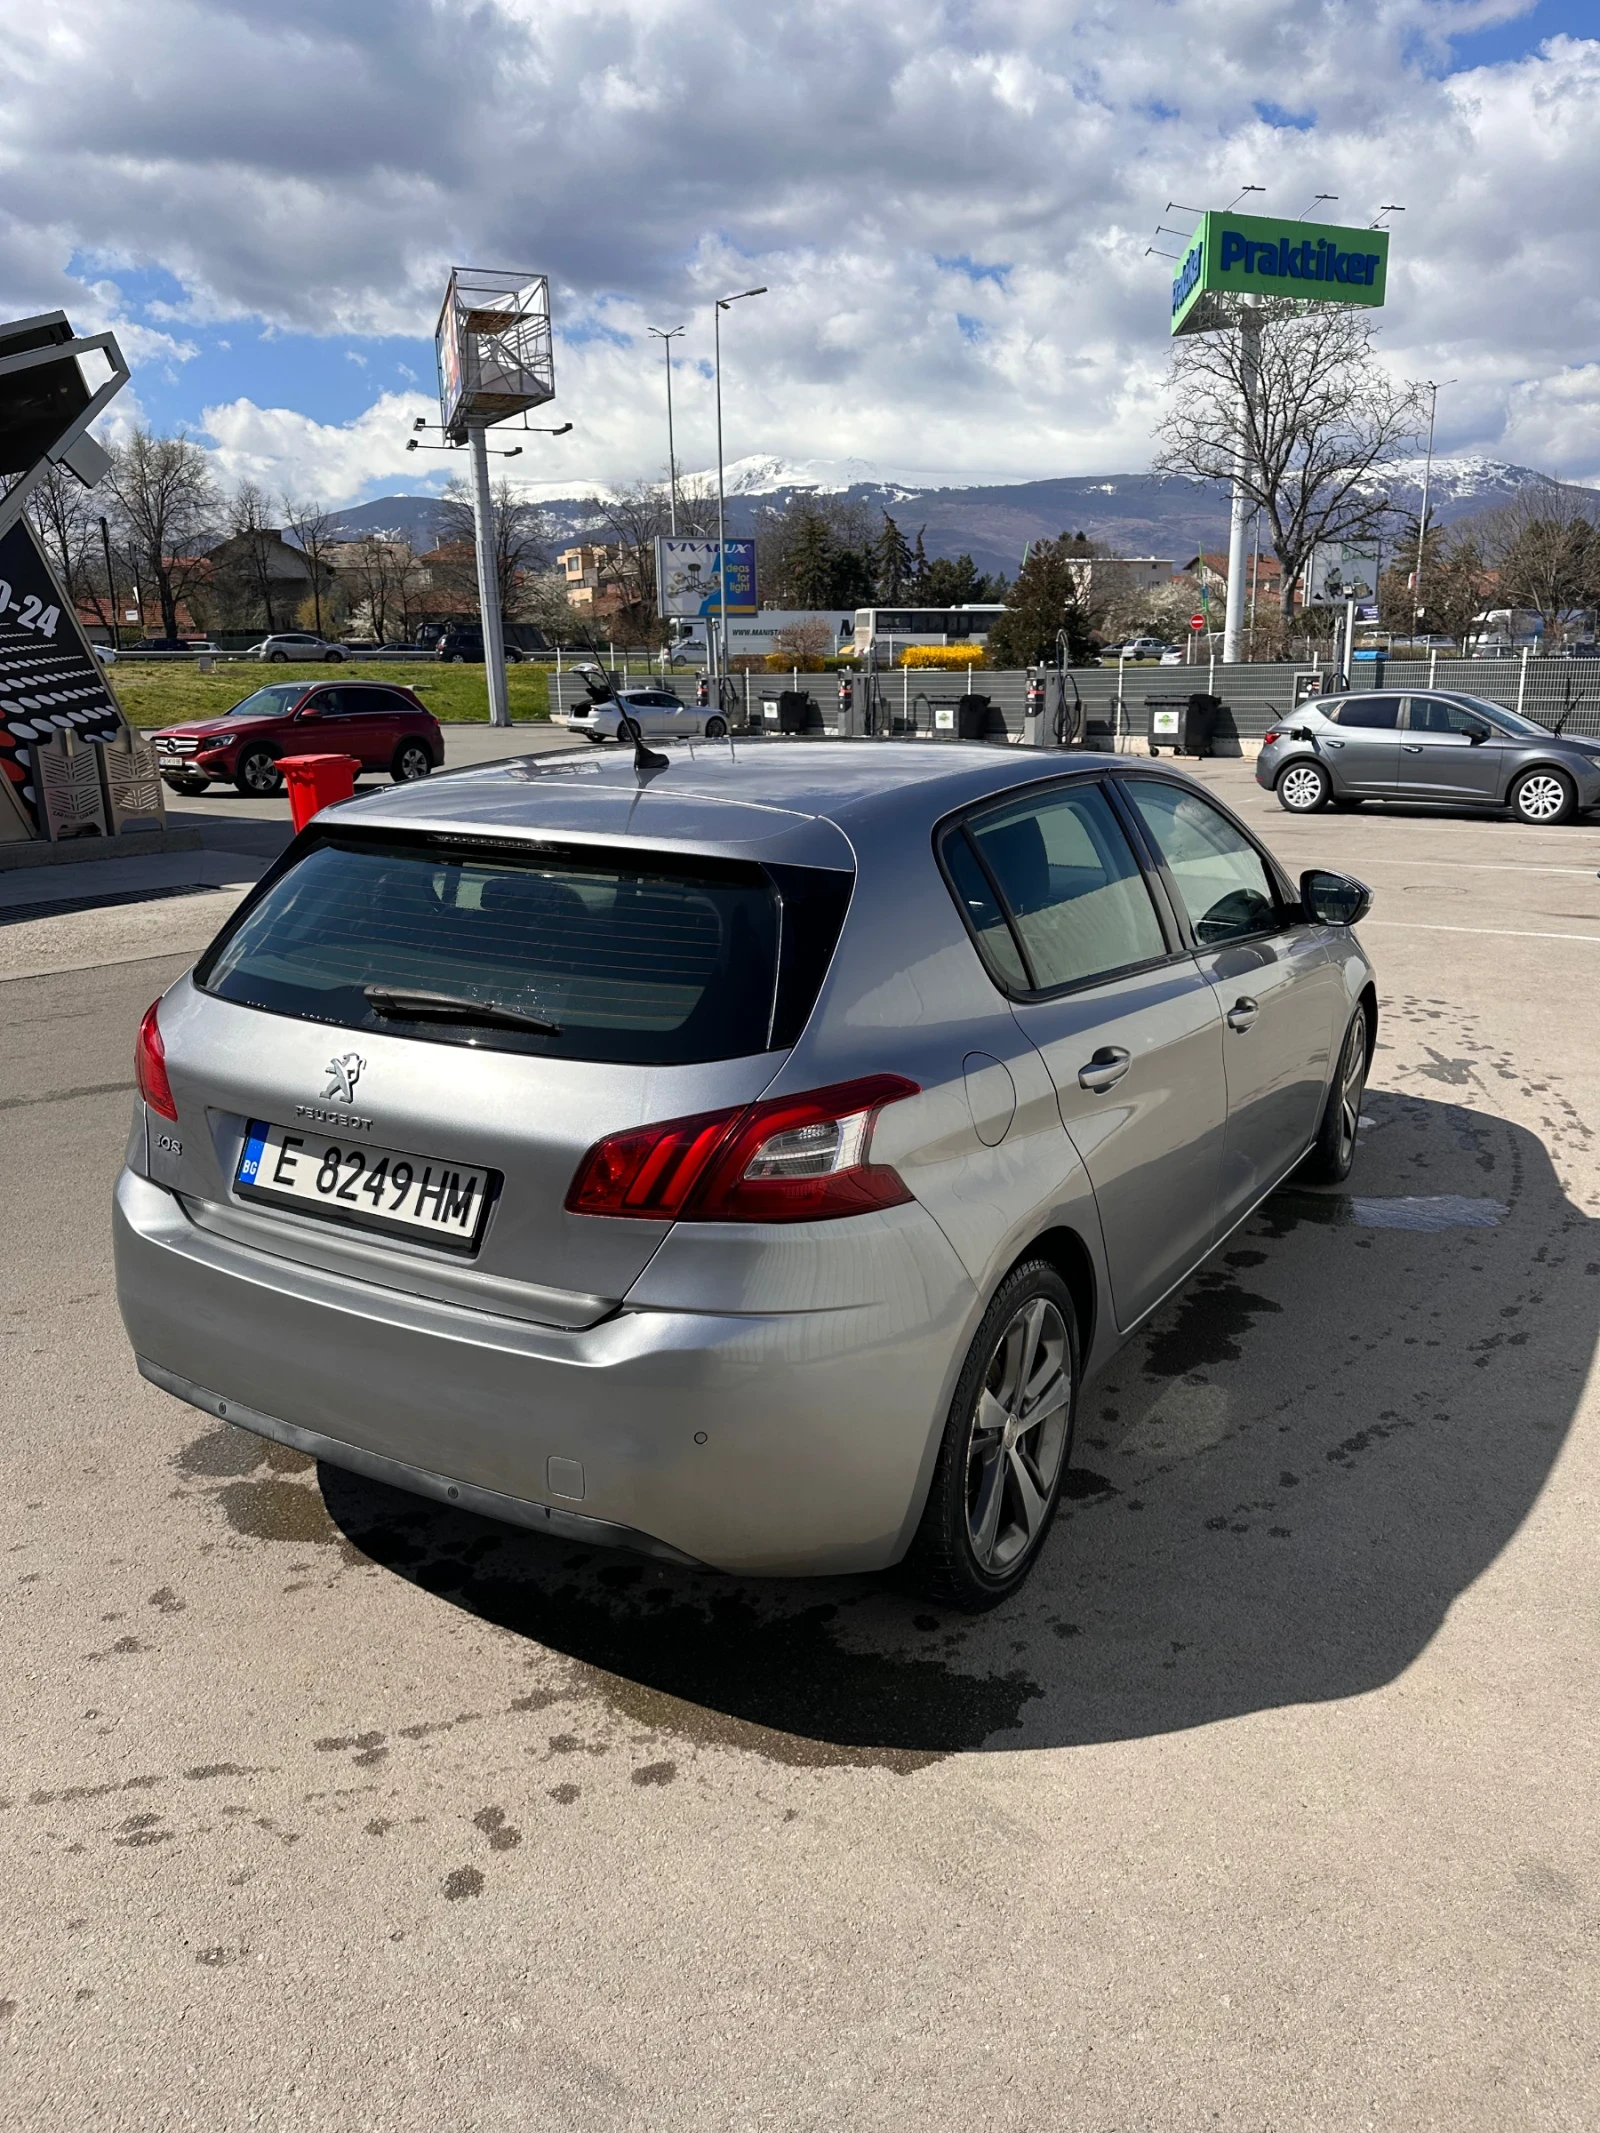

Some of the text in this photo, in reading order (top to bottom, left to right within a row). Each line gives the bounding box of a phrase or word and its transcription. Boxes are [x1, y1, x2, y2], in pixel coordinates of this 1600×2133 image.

[1221, 231, 1380, 286] Praktiker
[730, 582, 750, 594] light
[737, 573, 750, 582] for
[295, 1104, 374, 1132] PEUGEOT
[242, 1159, 258, 1176] BG
[273, 1135, 304, 1186] E
